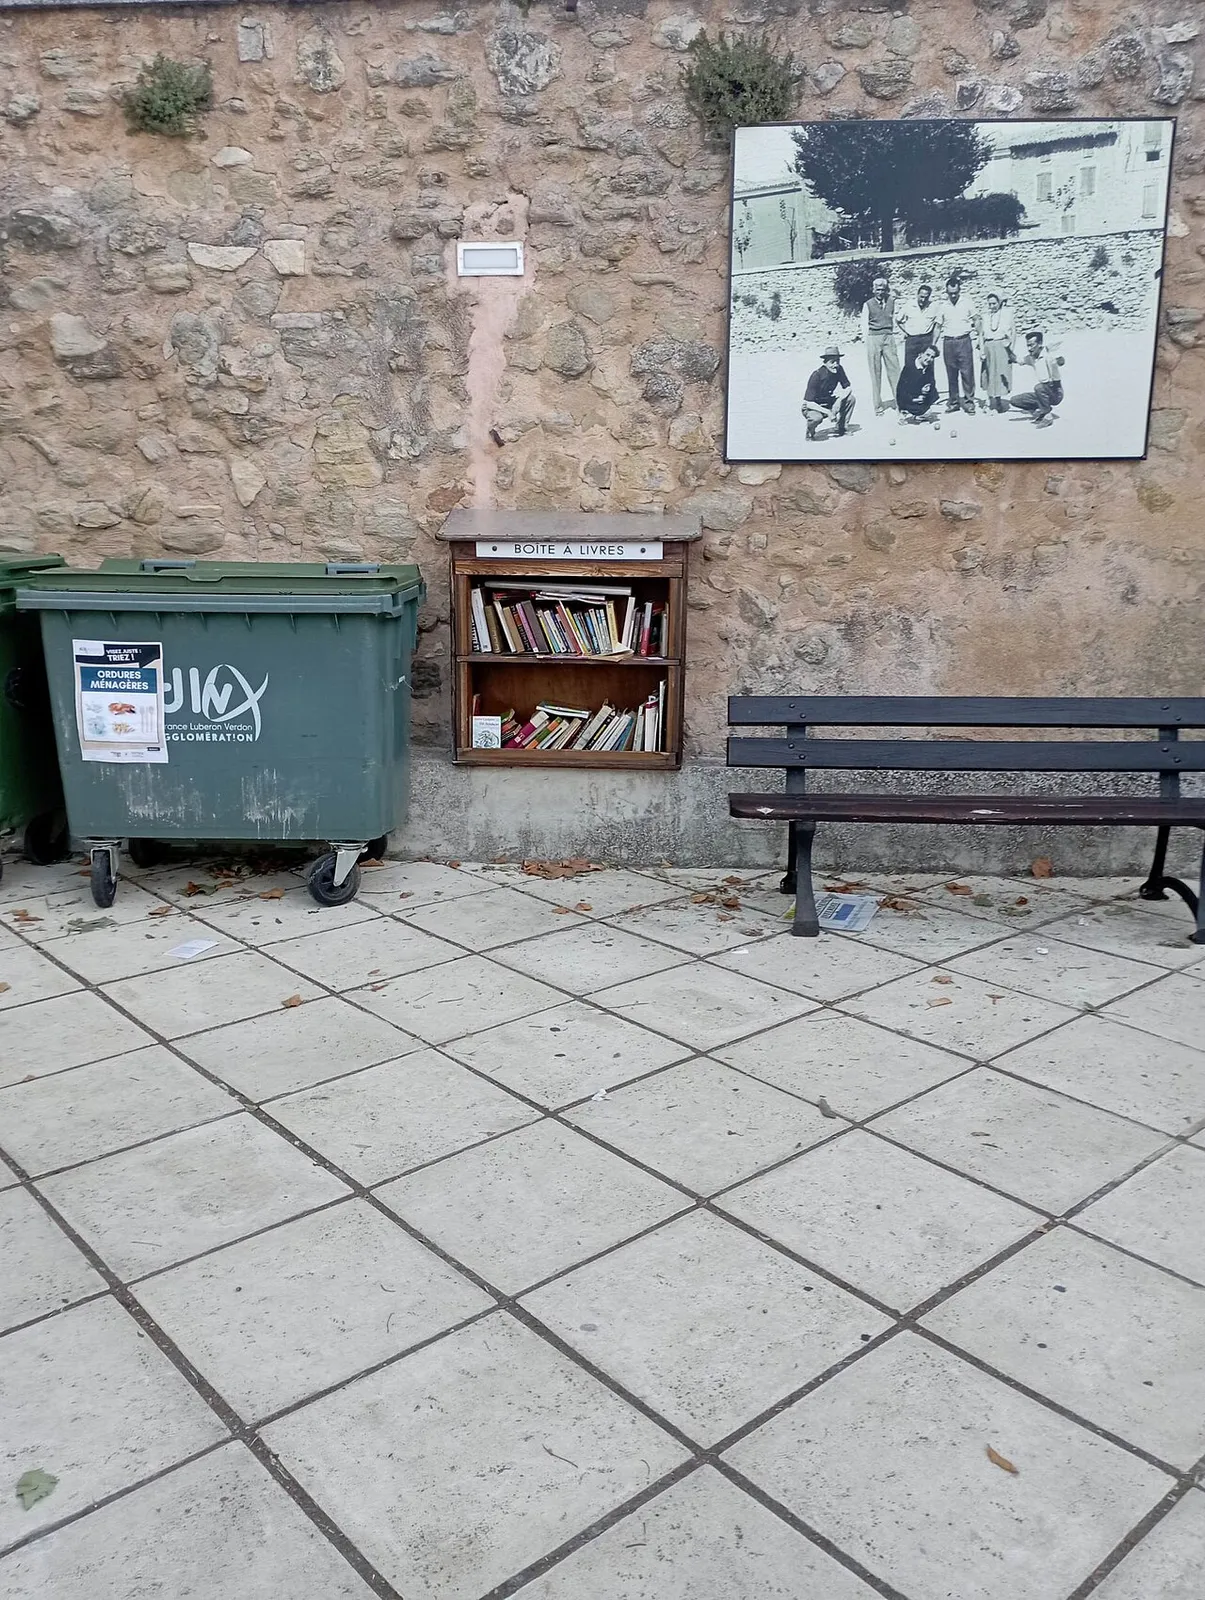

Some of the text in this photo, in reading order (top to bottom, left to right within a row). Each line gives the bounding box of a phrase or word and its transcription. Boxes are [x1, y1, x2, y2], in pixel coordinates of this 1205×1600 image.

[514, 543, 555, 555] BOÎTE
[580, 545, 624, 555] LIVRES
[97, 670, 141, 679] ORDURES
[90, 679, 149, 690] MÉNAGÈRES
[190, 723, 222, 731] Luberon
[224, 723, 252, 731] Verdon
[165, 732, 253, 741] GGLOMÉRATION
